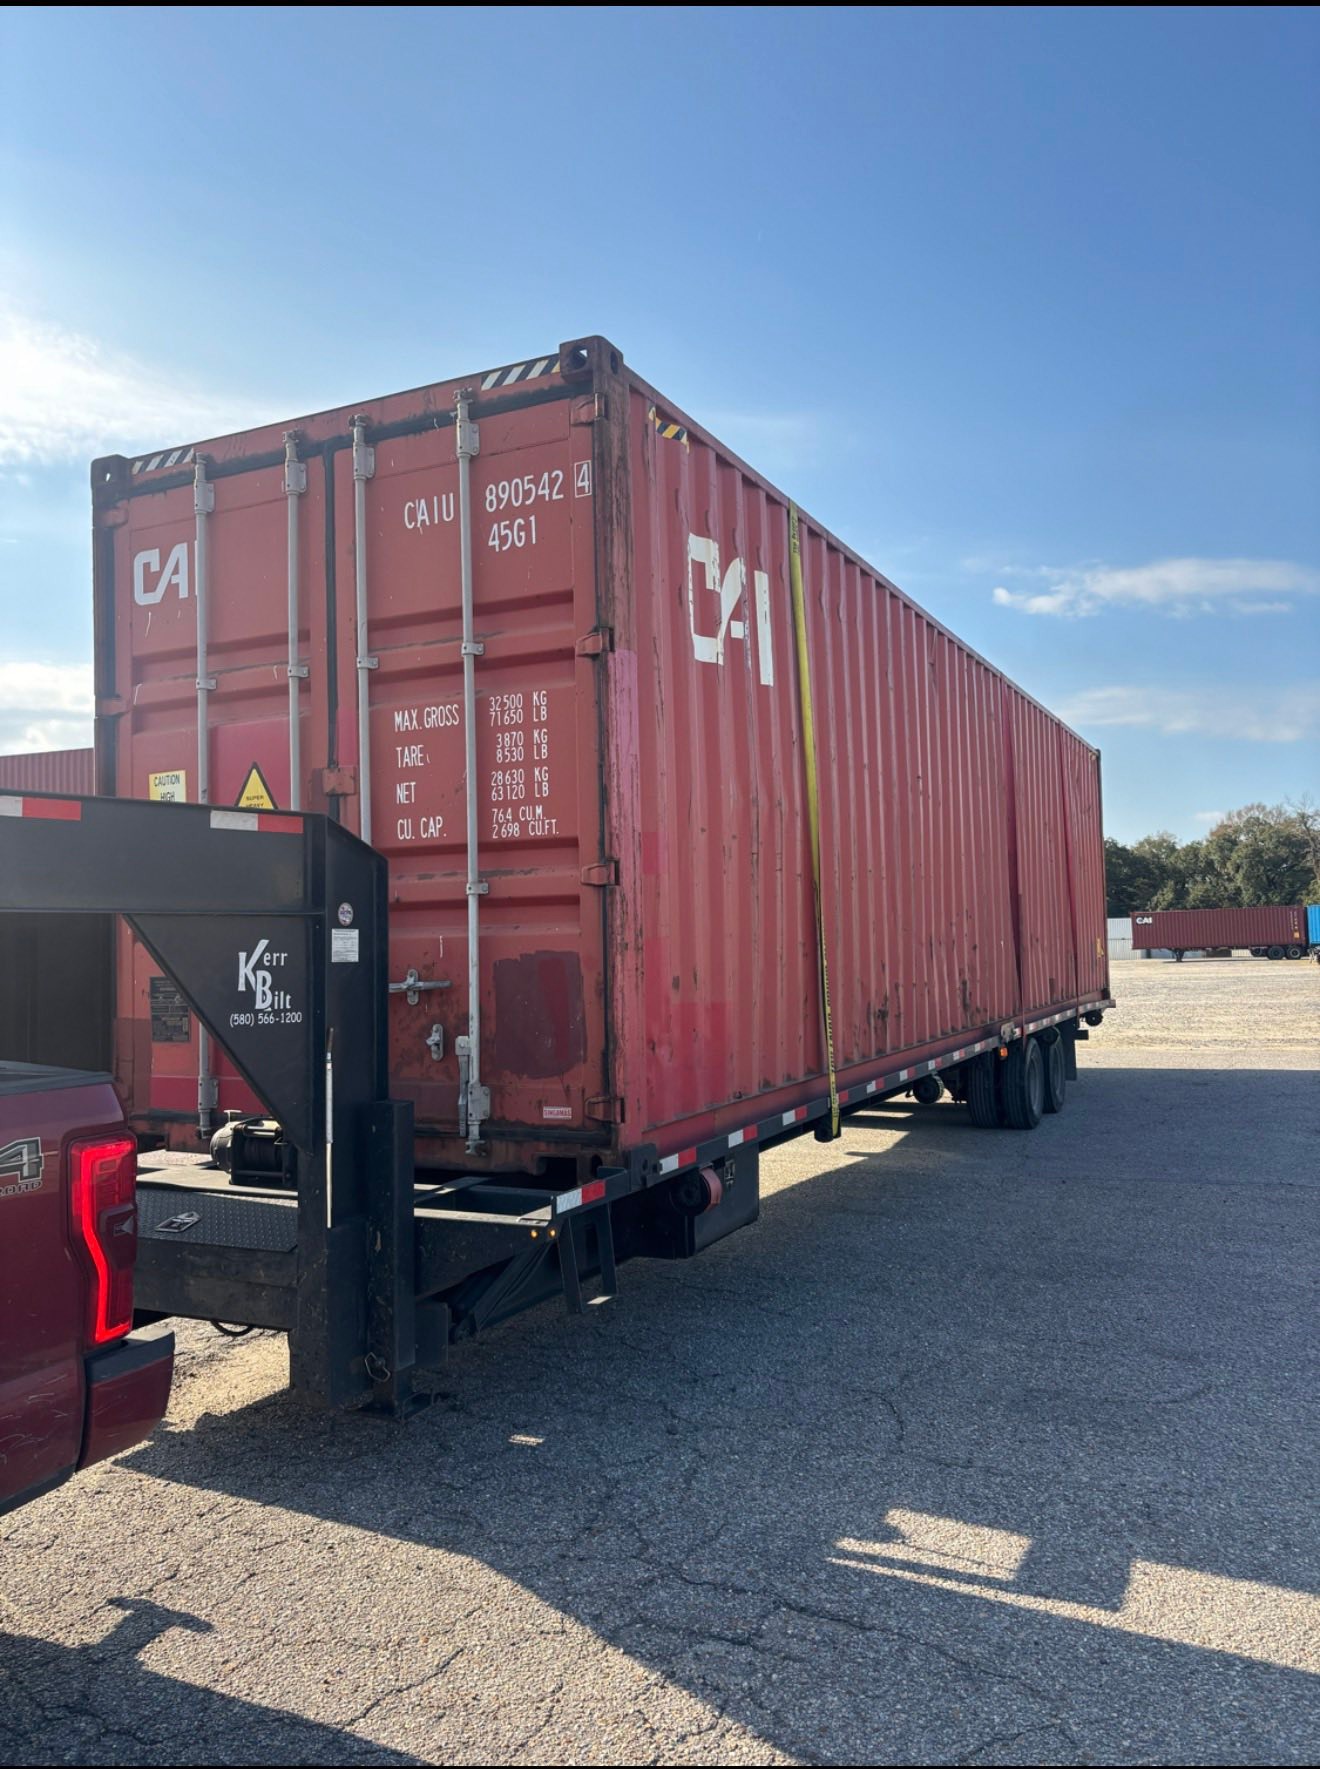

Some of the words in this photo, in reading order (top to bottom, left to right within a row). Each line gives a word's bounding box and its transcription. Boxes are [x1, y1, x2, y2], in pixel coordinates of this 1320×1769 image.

[404, 492, 455, 529] CAIU
[485, 470, 564, 512] 890542
[576, 462, 591, 494] 4
[488, 515, 536, 552] 45G1
[134, 541, 198, 606] CA
[533, 690, 547, 706] KG
[533, 706, 547, 722] LB
[533, 728, 548, 744] KG
[396, 745, 424, 768] TARE
[534, 744, 548, 760] LB
[154, 774, 181, 787] CAUTION
[534, 766, 549, 782] KG
[160, 791, 175, 802] HIGH
[396, 782, 416, 804] NET
[534, 782, 549, 798] LB
[397, 818, 415, 840] CU.
[420, 816, 447, 839] CAP.
[238, 939, 288, 992] Kerr
[255, 970, 292, 1011] Bilt
[229, 1013, 255, 1027] (580)
[257, 1011, 302, 1024] 566-1200
